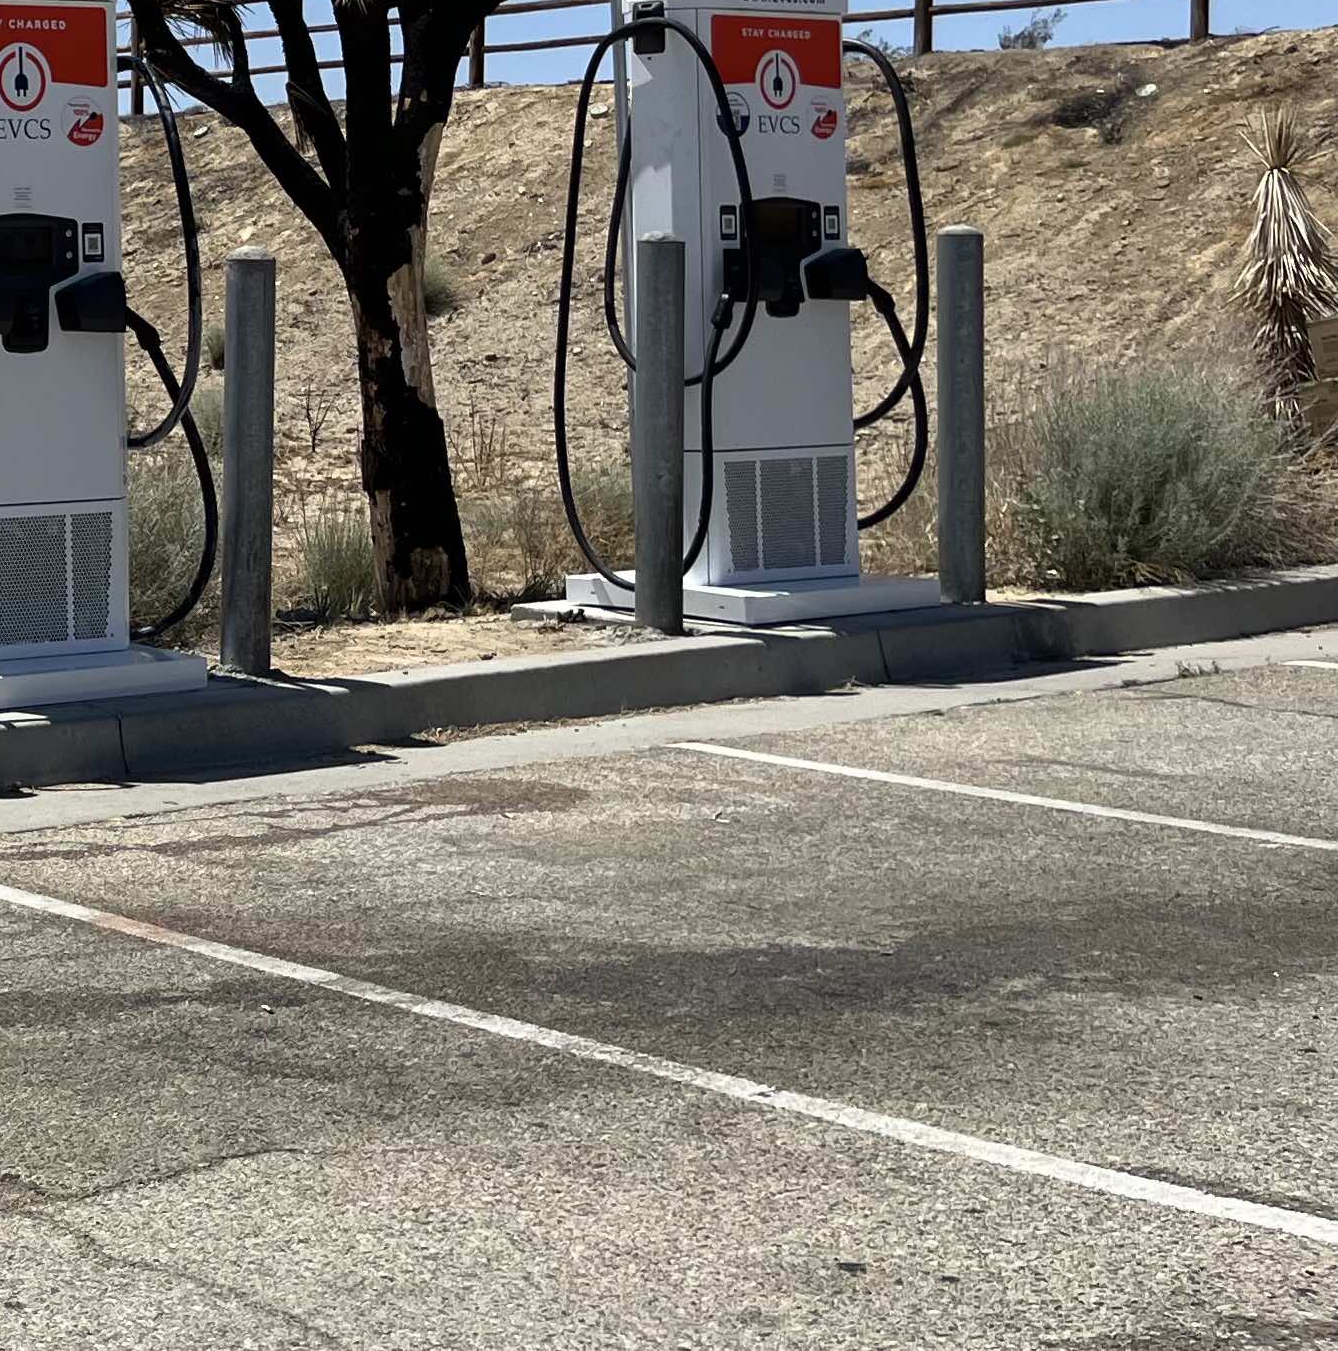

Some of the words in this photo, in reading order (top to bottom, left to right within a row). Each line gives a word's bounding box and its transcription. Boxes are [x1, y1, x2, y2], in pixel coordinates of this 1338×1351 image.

[8, 19, 67, 30] CHARGED
[741, 27, 766, 38] STAY
[767, 28, 812, 40] CHARGED
[758, 115, 801, 135] EVCS
